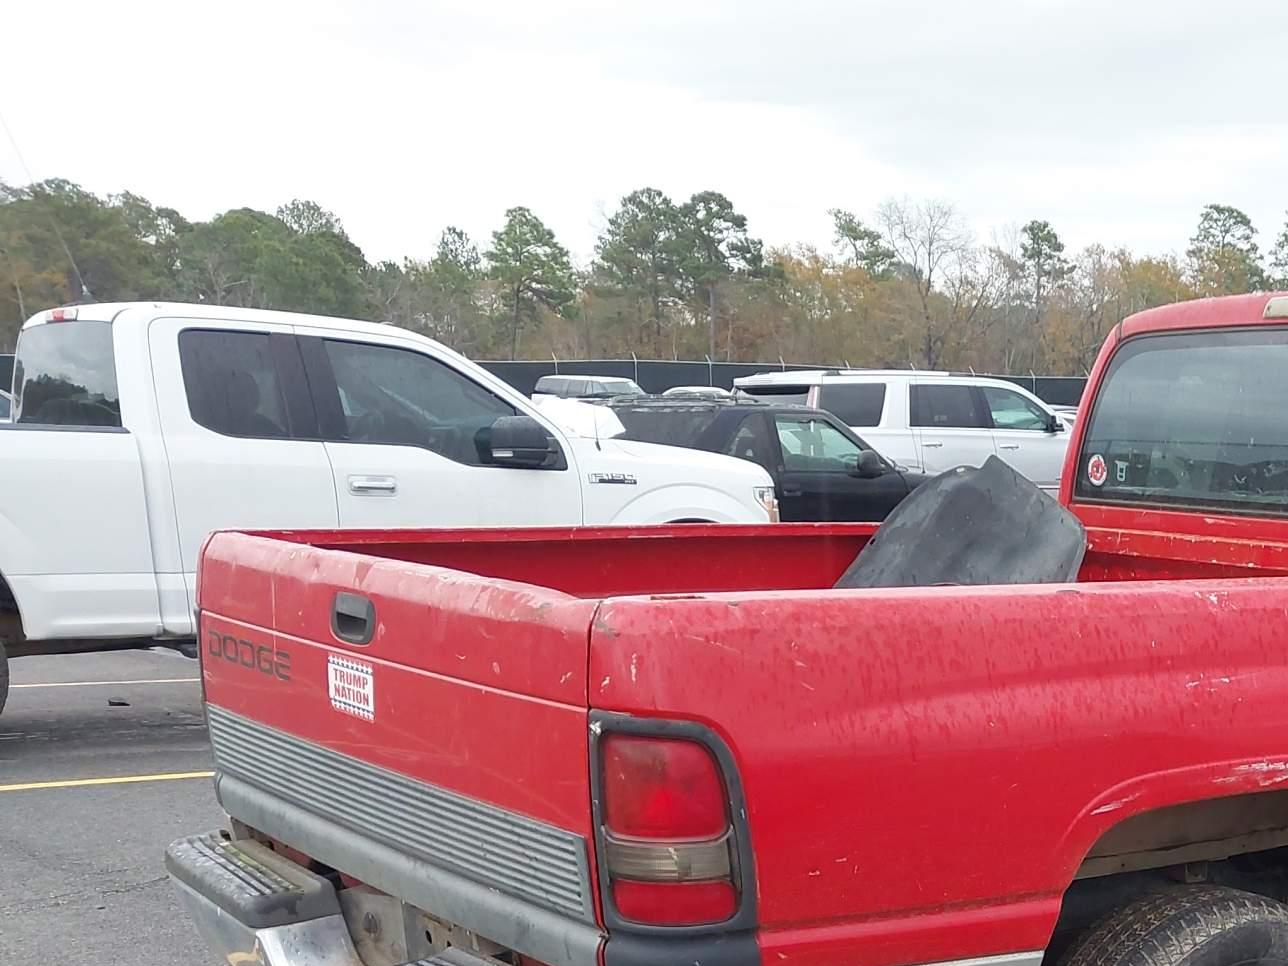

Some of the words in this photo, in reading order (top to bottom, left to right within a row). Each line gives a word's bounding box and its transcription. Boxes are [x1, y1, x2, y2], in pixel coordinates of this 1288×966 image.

[207, 630, 292, 681] DODGE
[332, 667, 369, 691] TRUMP
[332, 684, 371, 707] NATION
